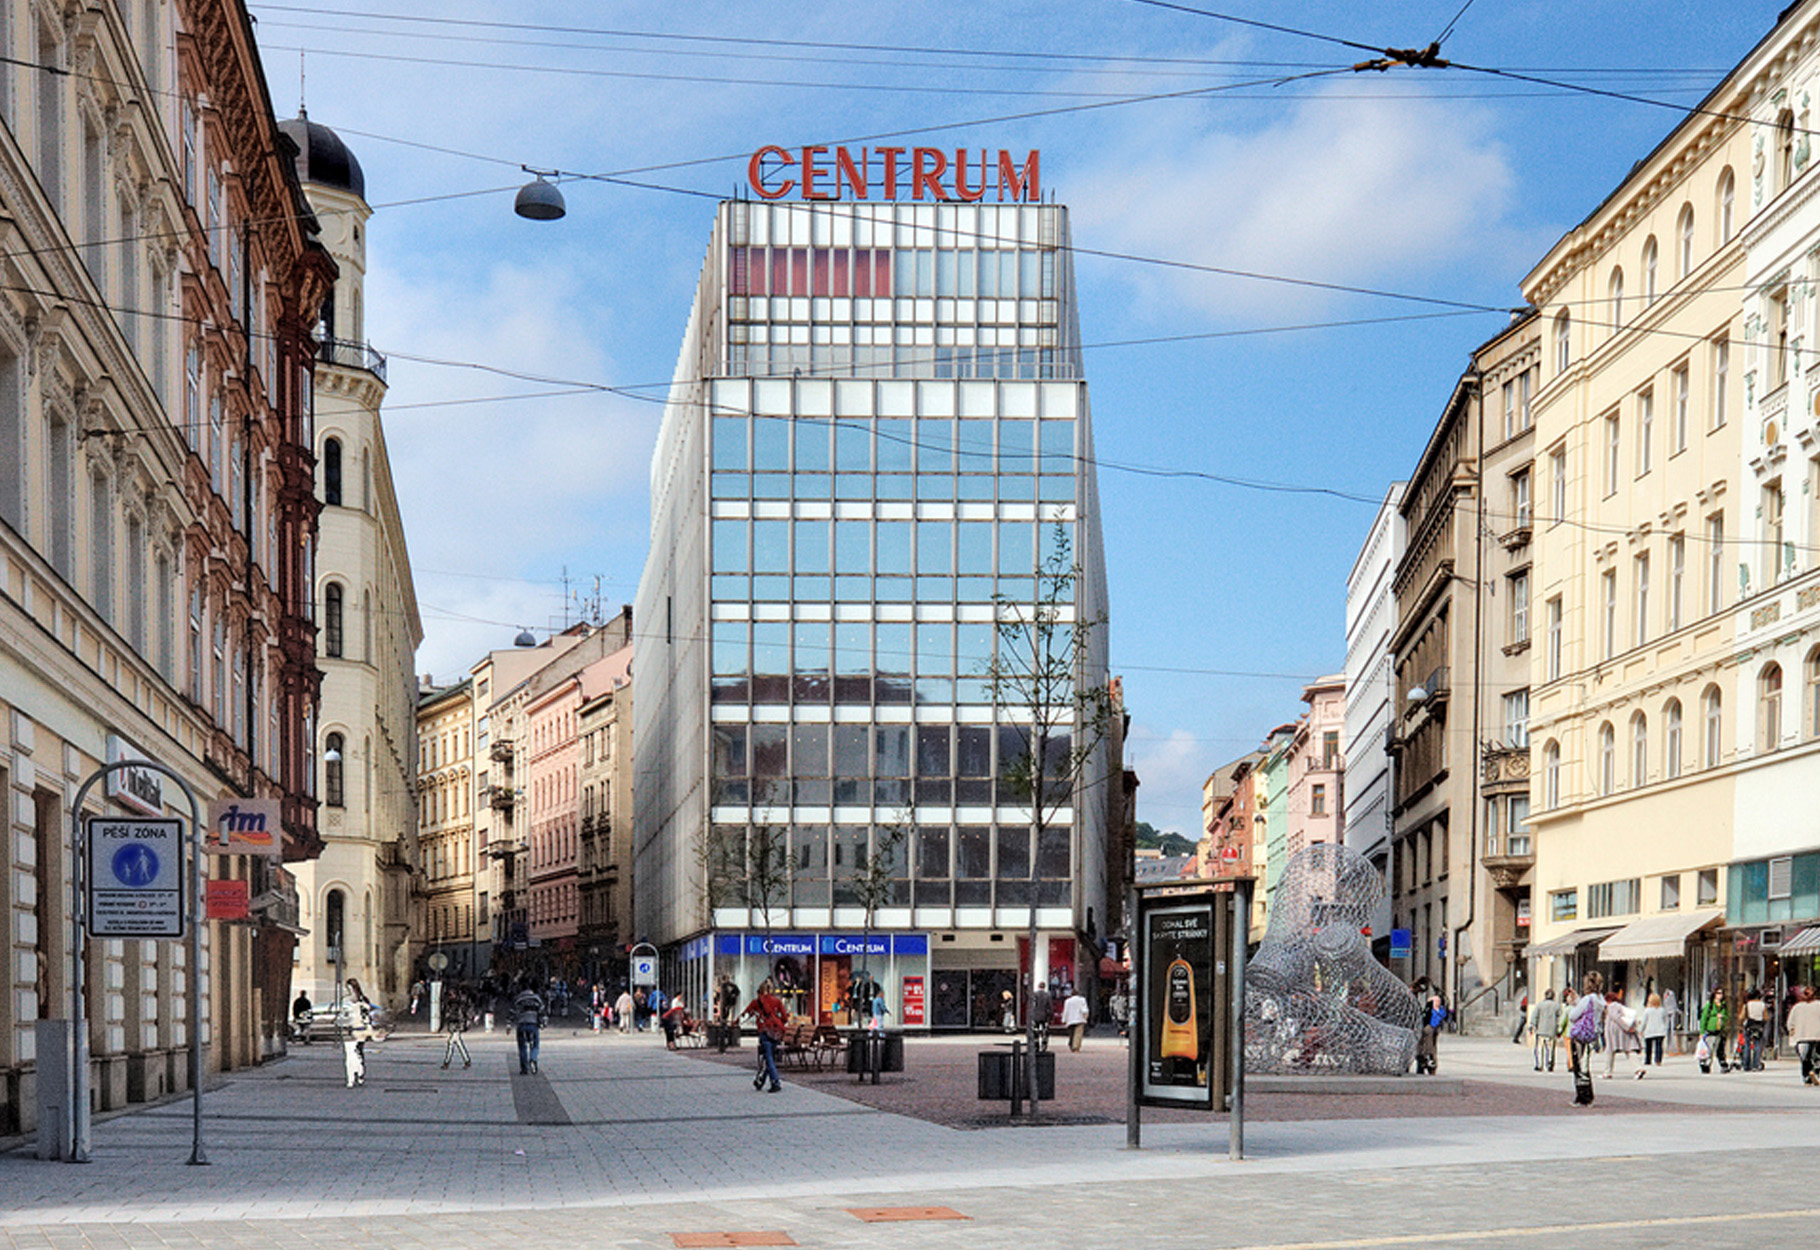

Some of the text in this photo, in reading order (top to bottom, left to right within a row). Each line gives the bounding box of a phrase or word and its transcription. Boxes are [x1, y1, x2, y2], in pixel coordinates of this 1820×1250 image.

[748, 145, 1040, 203] CENTRUM
[219, 805, 266, 831] dm
[102, 826, 167, 839] PĚŠÍ ZÓNA
[763, 939, 812, 953] CENTRUM
